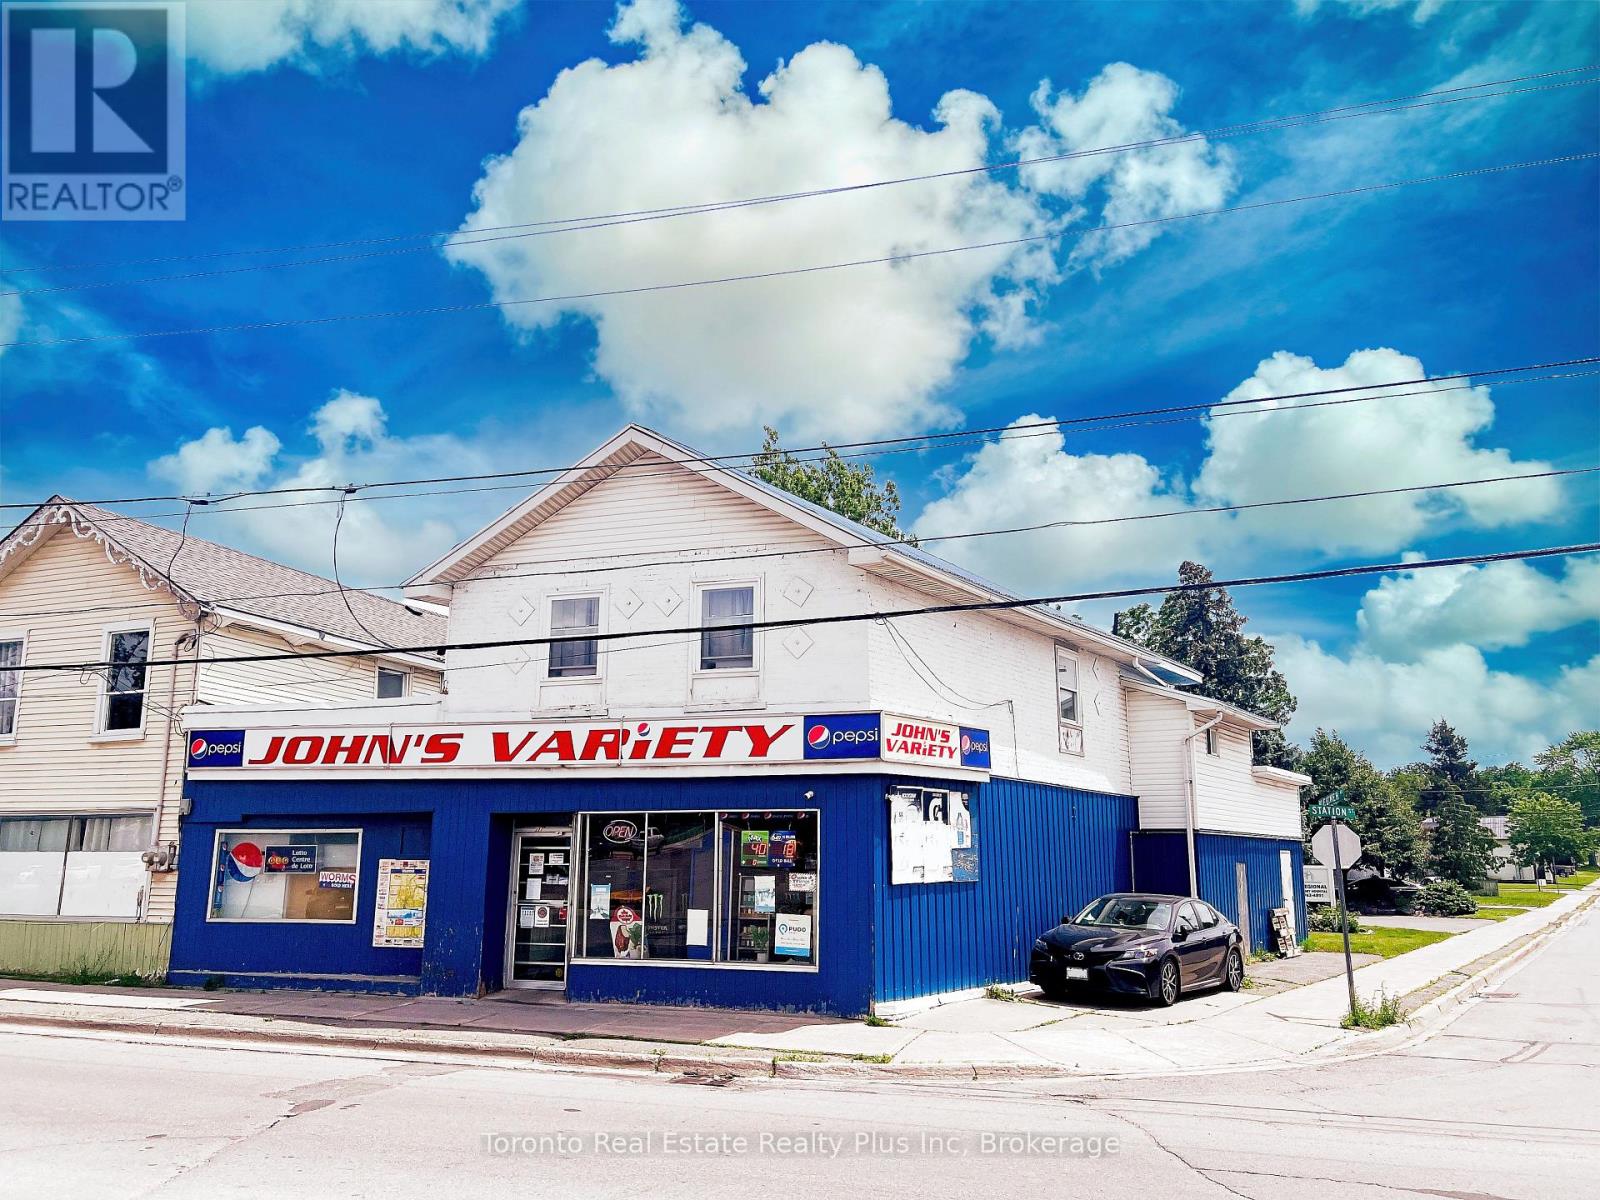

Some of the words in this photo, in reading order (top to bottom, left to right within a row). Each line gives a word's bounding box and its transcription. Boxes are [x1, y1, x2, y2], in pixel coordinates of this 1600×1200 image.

[833, 727, 879, 745] pepsi
[891, 723, 951, 743] JOHN'S
[208, 741, 241, 755] pepsi
[248, 733, 464, 765] JOHN'S
[970, 740, 989, 754] pepsi
[1311, 806, 1347, 816] STATION
[604, 825, 635, 838] OPEN
[751, 843, 767, 855] 40
[782, 843, 795, 856] 18
[321, 873, 356, 884] WORMS
